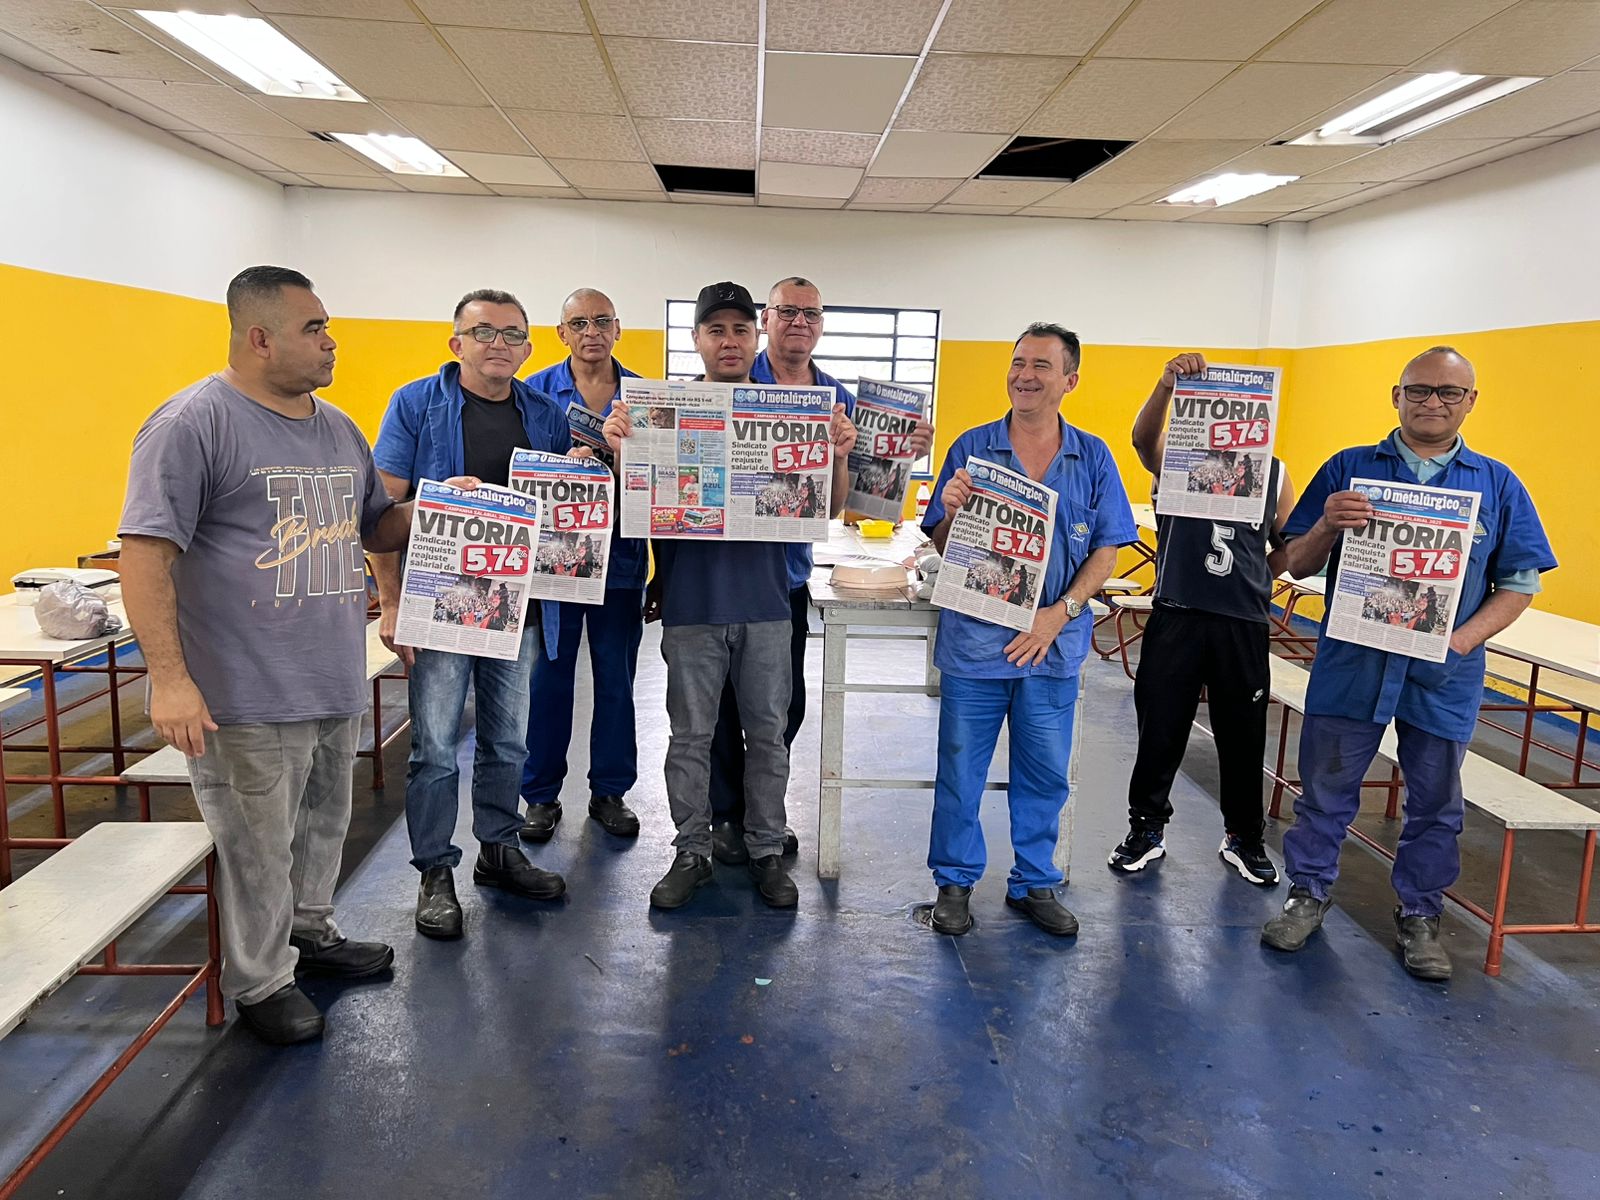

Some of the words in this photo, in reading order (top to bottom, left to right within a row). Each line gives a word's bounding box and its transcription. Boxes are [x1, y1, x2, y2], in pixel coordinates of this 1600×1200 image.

[1208, 370, 1263, 385] metalúrgico
[760, 390, 766, 403] O
[767, 392, 822, 407] metalúrgico
[1174, 398, 1270, 422] VITÓRIA
[1171, 418, 1204, 426] Sindicato
[732, 420, 829, 443] VITÓRIA
[512, 479, 609, 504] VITÓRIA
[990, 469, 997, 481] O
[997, 472, 1043, 502] metalúrgico
[1383, 488, 1392, 501] O
[1392, 490, 1459, 510] metalúrgico
[444, 505, 473, 515] CAMPANHA
[474, 509, 498, 518] SALARIAL
[963, 494, 1046, 542] VITÓRIA
[1375, 512, 1403, 520] CAMPANHA
[958, 513, 990, 526] Sindicato
[418, 510, 531, 550] VITÓRIA
[953, 526, 983, 539] reajuste
[955, 520, 990, 533] conquista
[255, 500, 360, 569] Break
[267, 474, 365, 596] THE
[414, 534, 456, 547] Sindicato
[951, 533, 977, 545] salarial
[1352, 518, 1462, 554] VITÓRIA
[413, 542, 456, 555] conquista
[1204, 522, 1235, 577] 5
[1347, 537, 1385, 550] Sindicato
[411, 551, 448, 563] reajuste
[1344, 553, 1377, 564] reajuste
[1345, 546, 1385, 558] conquista
[410, 560, 443, 570] salarial
[444, 564, 455, 572] de
[1343, 560, 1372, 571] salarial
